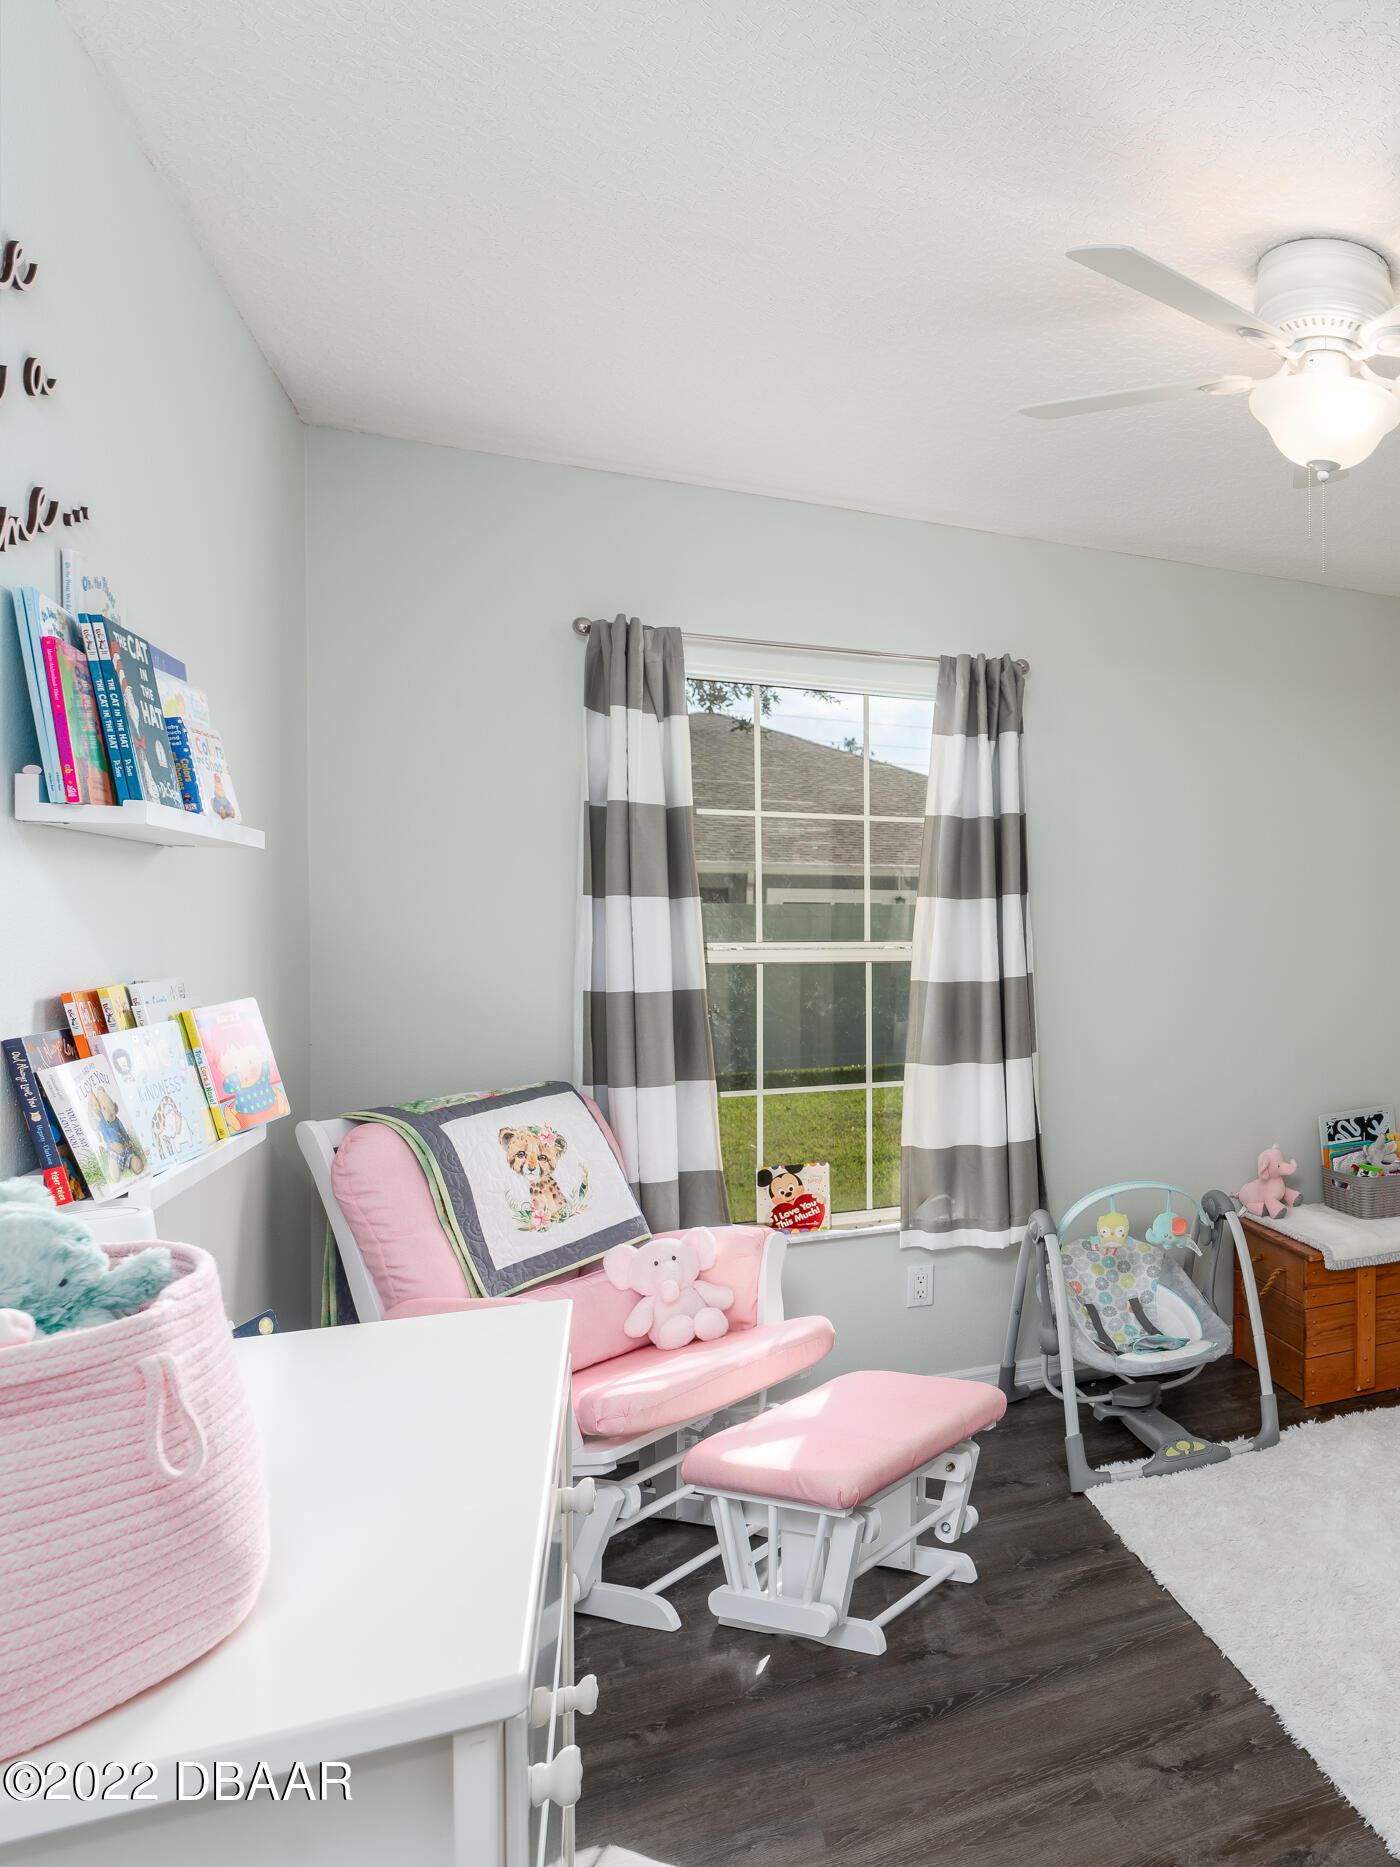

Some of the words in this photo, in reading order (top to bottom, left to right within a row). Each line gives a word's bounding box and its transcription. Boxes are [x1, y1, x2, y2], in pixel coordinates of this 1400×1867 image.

[113, 631, 128, 652] THE
[126, 634, 149, 665] CAT
[139, 667, 149, 682] IN
[96, 678, 105, 691] THE
[107, 678, 116, 691] THE
[110, 693, 120, 707] CAT
[140, 684, 155, 701] THE
[99, 694, 109, 708] CAT
[102, 709, 111, 718] IN
[114, 709, 122, 717] IN
[140, 700, 164, 731] HAT
[105, 719, 114, 732] THE
[117, 718, 125, 732] THE
[108, 734, 119, 750] HAT
[119, 733, 129, 749] HAT
[180, 758, 192, 782] Colors
[20, 1083, 33, 1097] Love
[26, 1096, 37, 1109] You
[65, 1107, 77, 1122] YOU
[72, 1123, 84, 1137] ARE
[60, 1115, 73, 1133] LOVE
[68, 1134, 80, 1149] YOU
[50, 1171, 61, 1186] tiger
[56, 1186, 66, 1201] tales
[774, 1214, 778, 1222] I
[779, 1207, 800, 1220] Love
[800, 1200, 817, 1210] You
[775, 1218, 794, 1230] This
[794, 1206, 821, 1223] Much!
